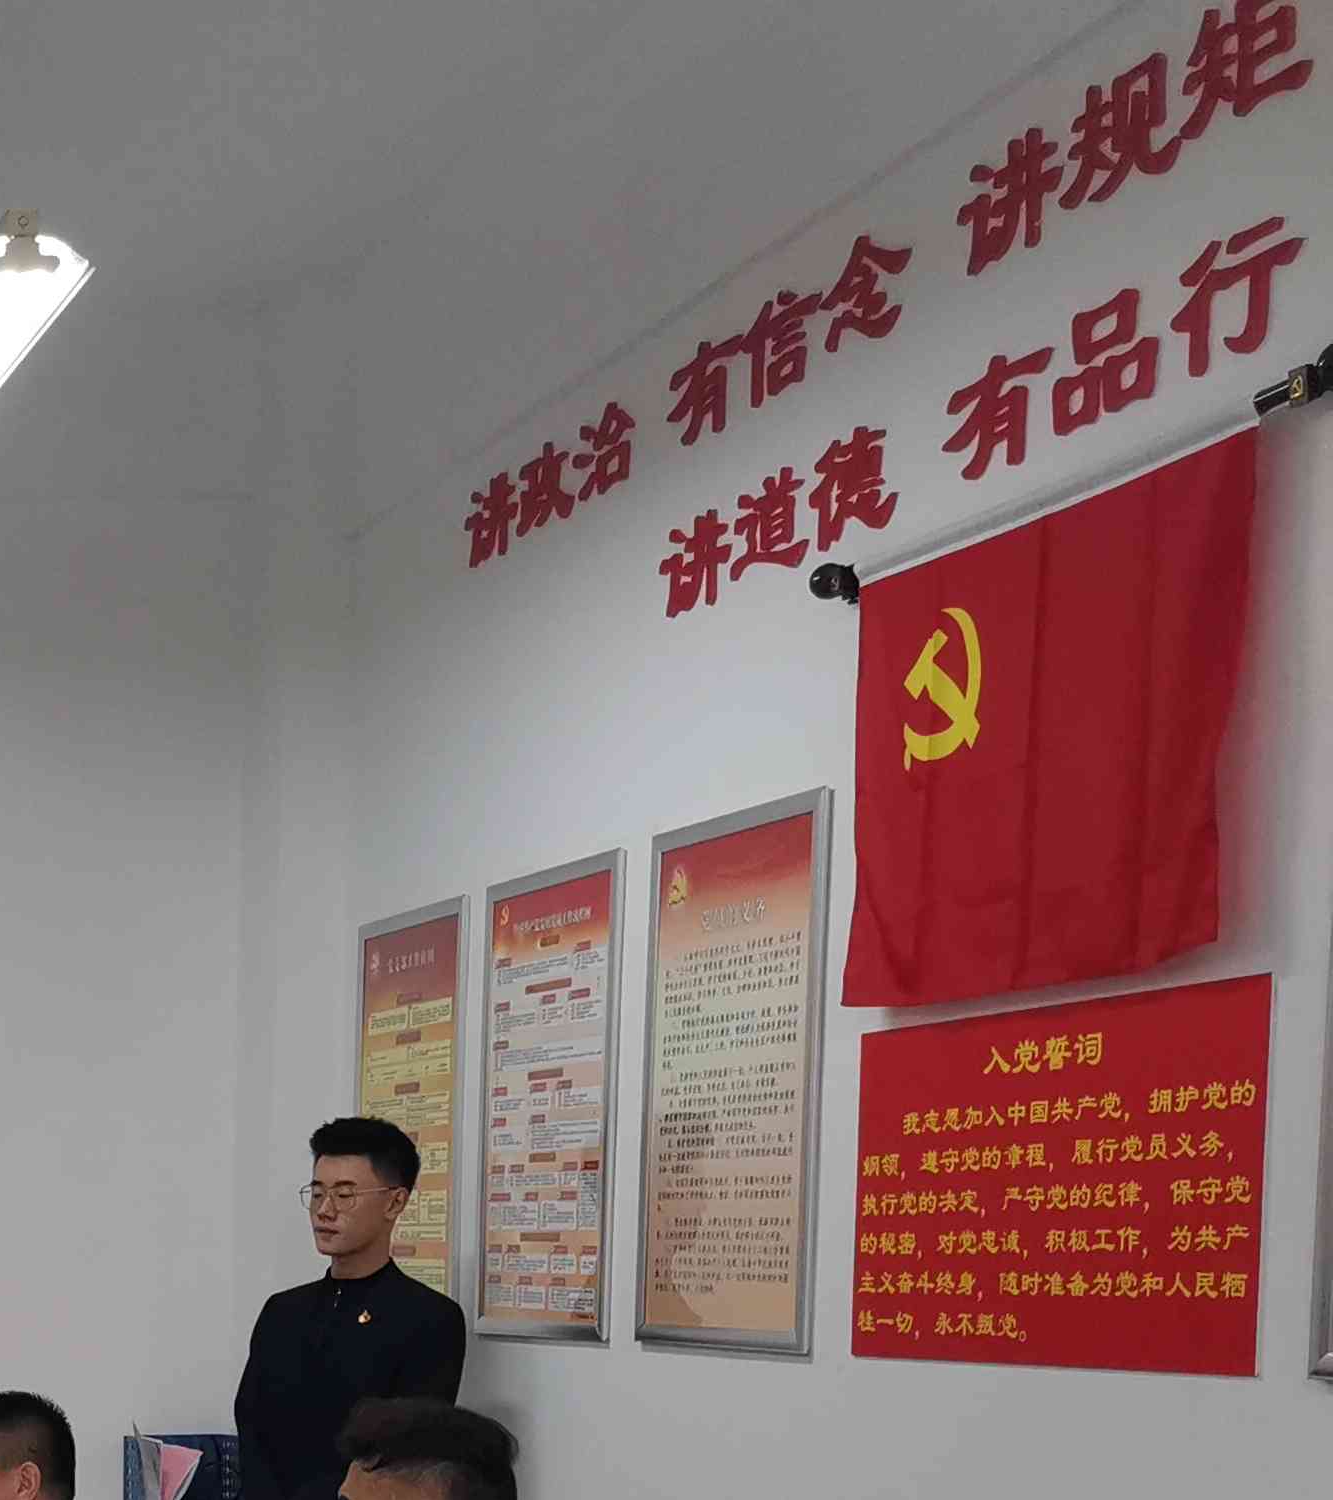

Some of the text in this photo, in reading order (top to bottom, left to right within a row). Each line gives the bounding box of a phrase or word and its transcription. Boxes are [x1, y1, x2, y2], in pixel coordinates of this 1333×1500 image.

[463, 0, 1314, 568] 讲政治 有信念 讲规矩
[657, 216, 1310, 618] 讲道德 有品行
[983, 1032, 1102, 1075] 入党誓词
